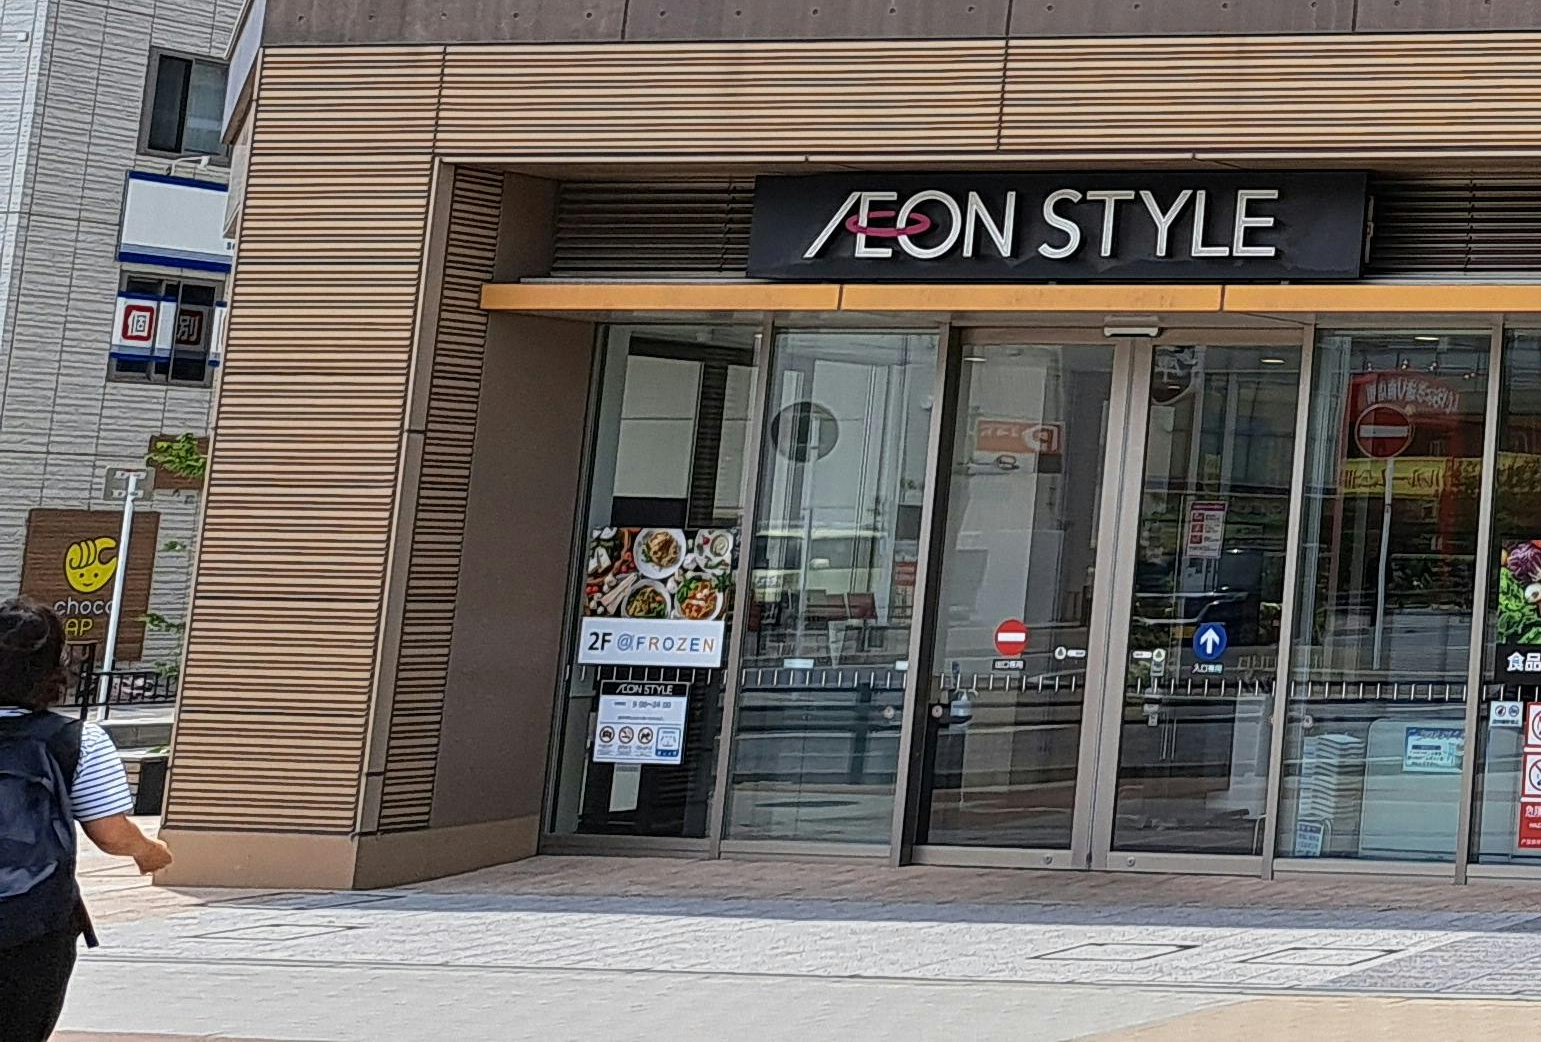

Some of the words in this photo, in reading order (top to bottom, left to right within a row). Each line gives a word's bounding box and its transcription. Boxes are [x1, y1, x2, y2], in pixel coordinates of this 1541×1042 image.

[1037, 189, 1279, 257] STYLE
[588, 631, 612, 651] 2F
[617, 633, 715, 653] @FROZEN
[644, 684, 674, 695] STYLE
